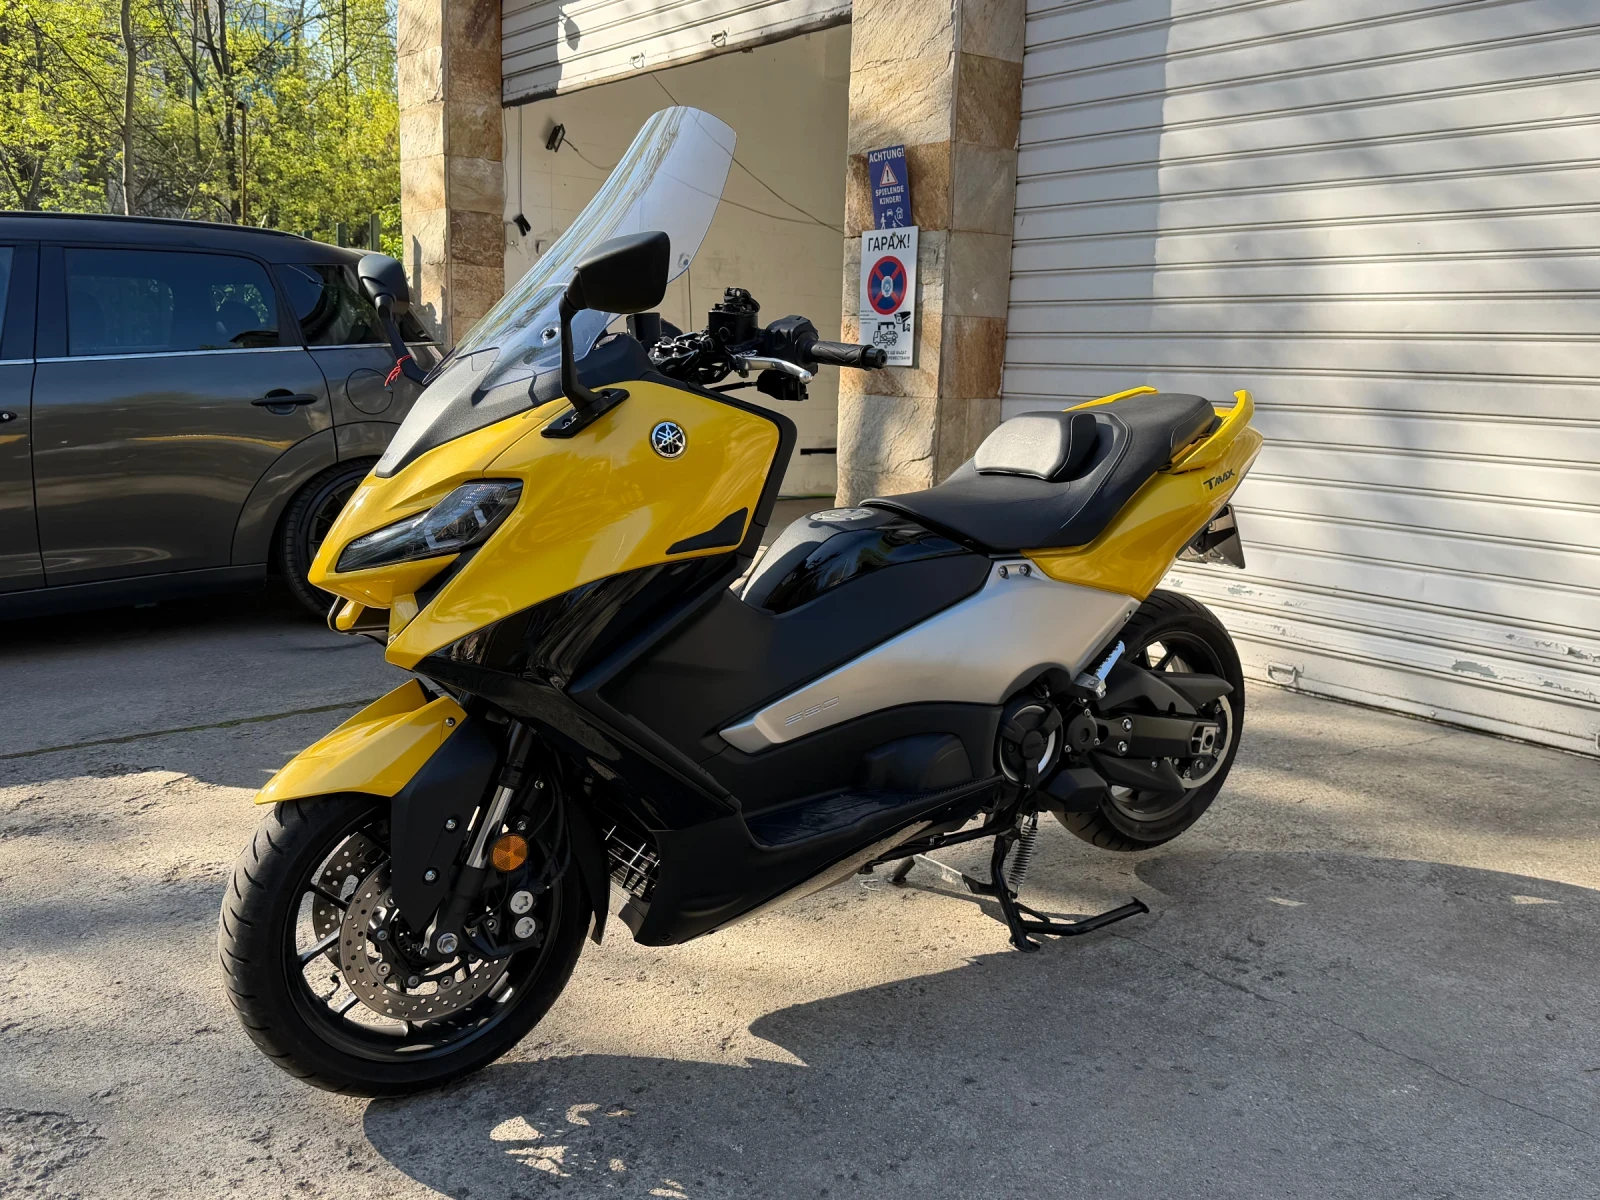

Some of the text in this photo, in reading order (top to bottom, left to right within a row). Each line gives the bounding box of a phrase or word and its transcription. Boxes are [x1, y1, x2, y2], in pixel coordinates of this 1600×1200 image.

[869, 148, 905, 163] ACHTUNG!
[875, 185, 905, 197] SPIELENDE
[880, 195, 902, 205] KINDER!
[868, 234, 910, 252] ГАРАЖ!
[1203, 469, 1236, 490] TMAX
